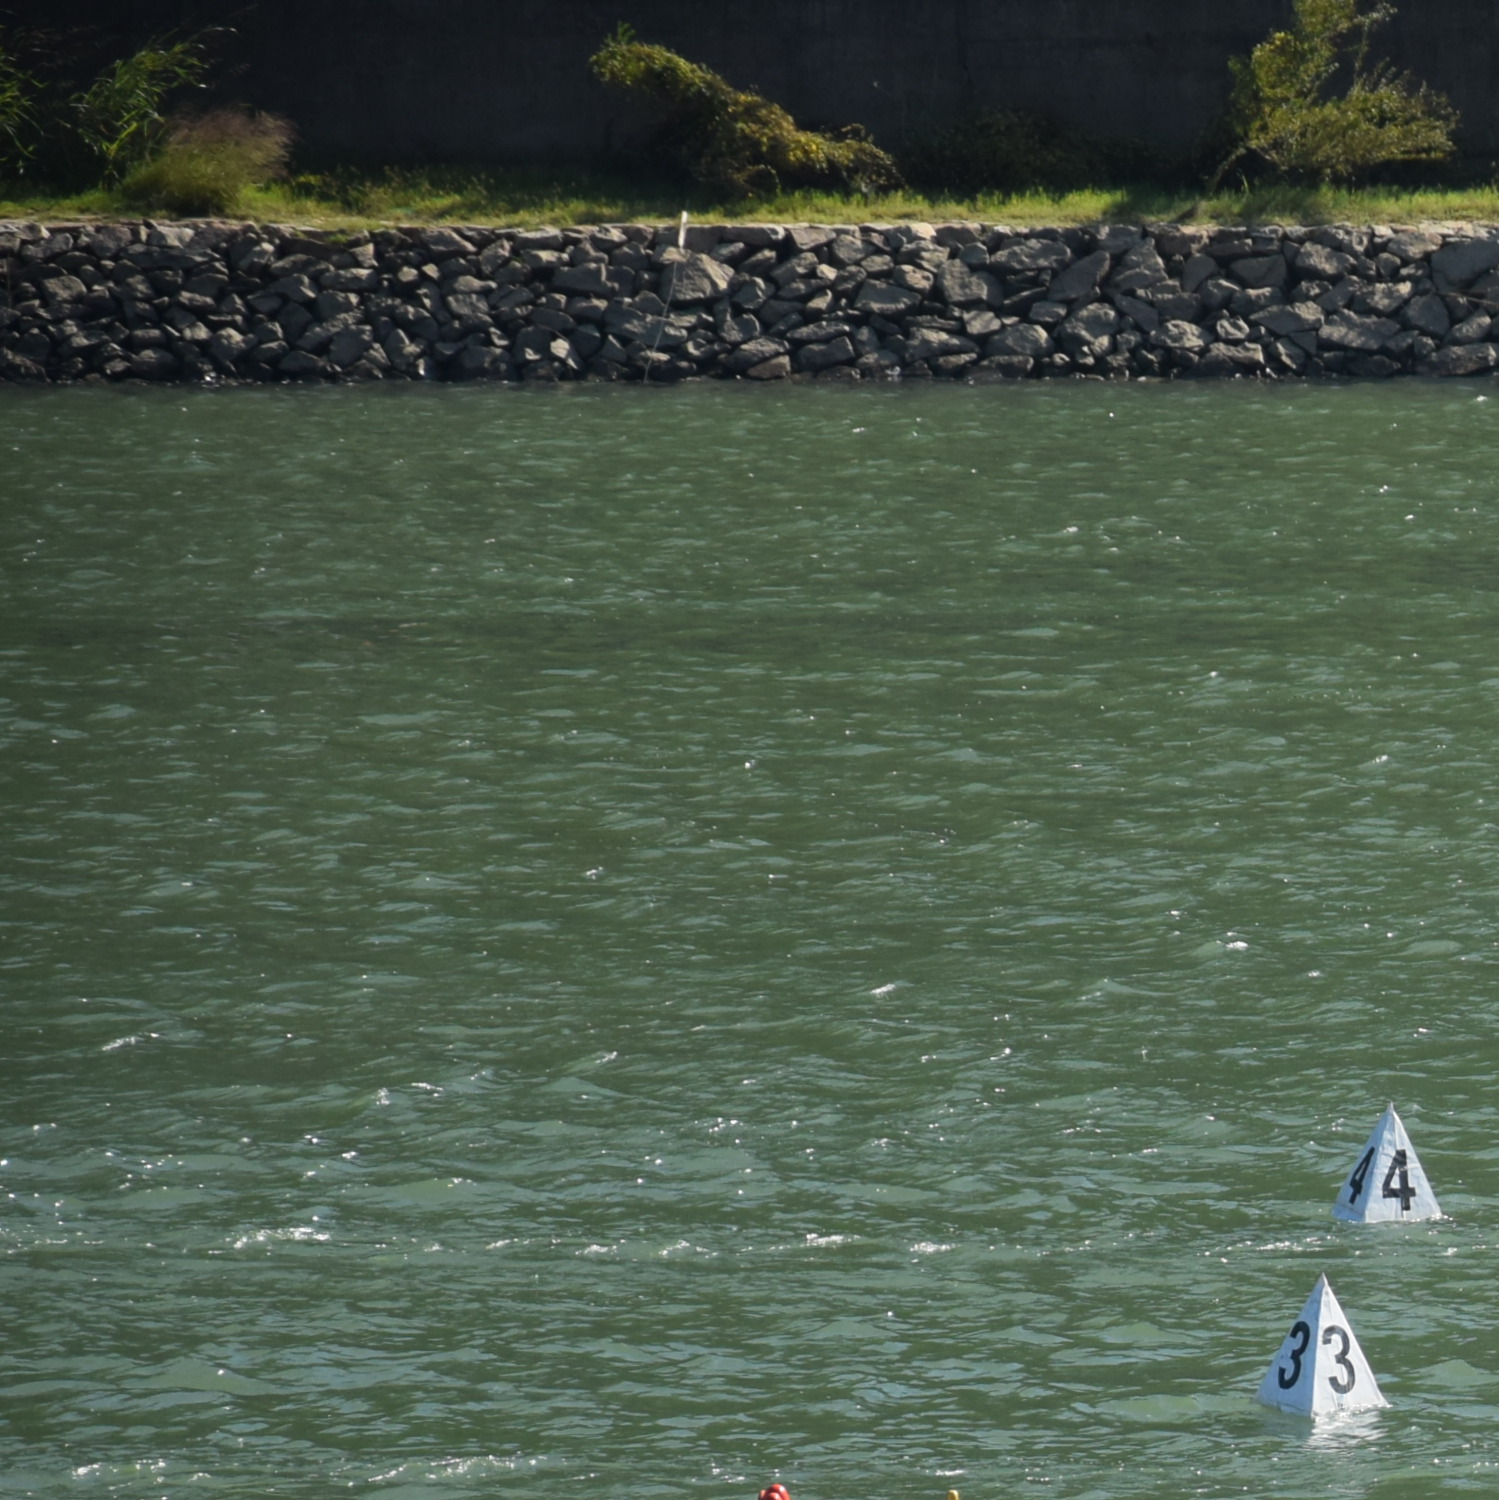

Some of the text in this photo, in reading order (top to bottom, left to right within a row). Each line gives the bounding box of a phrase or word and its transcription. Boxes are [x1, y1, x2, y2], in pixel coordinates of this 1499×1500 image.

[1348, 1146, 1375, 1205] 4
[1382, 1149, 1417, 1211] 4
[1278, 1320, 1310, 1390] 3
[1322, 1325, 1355, 1394] 3
